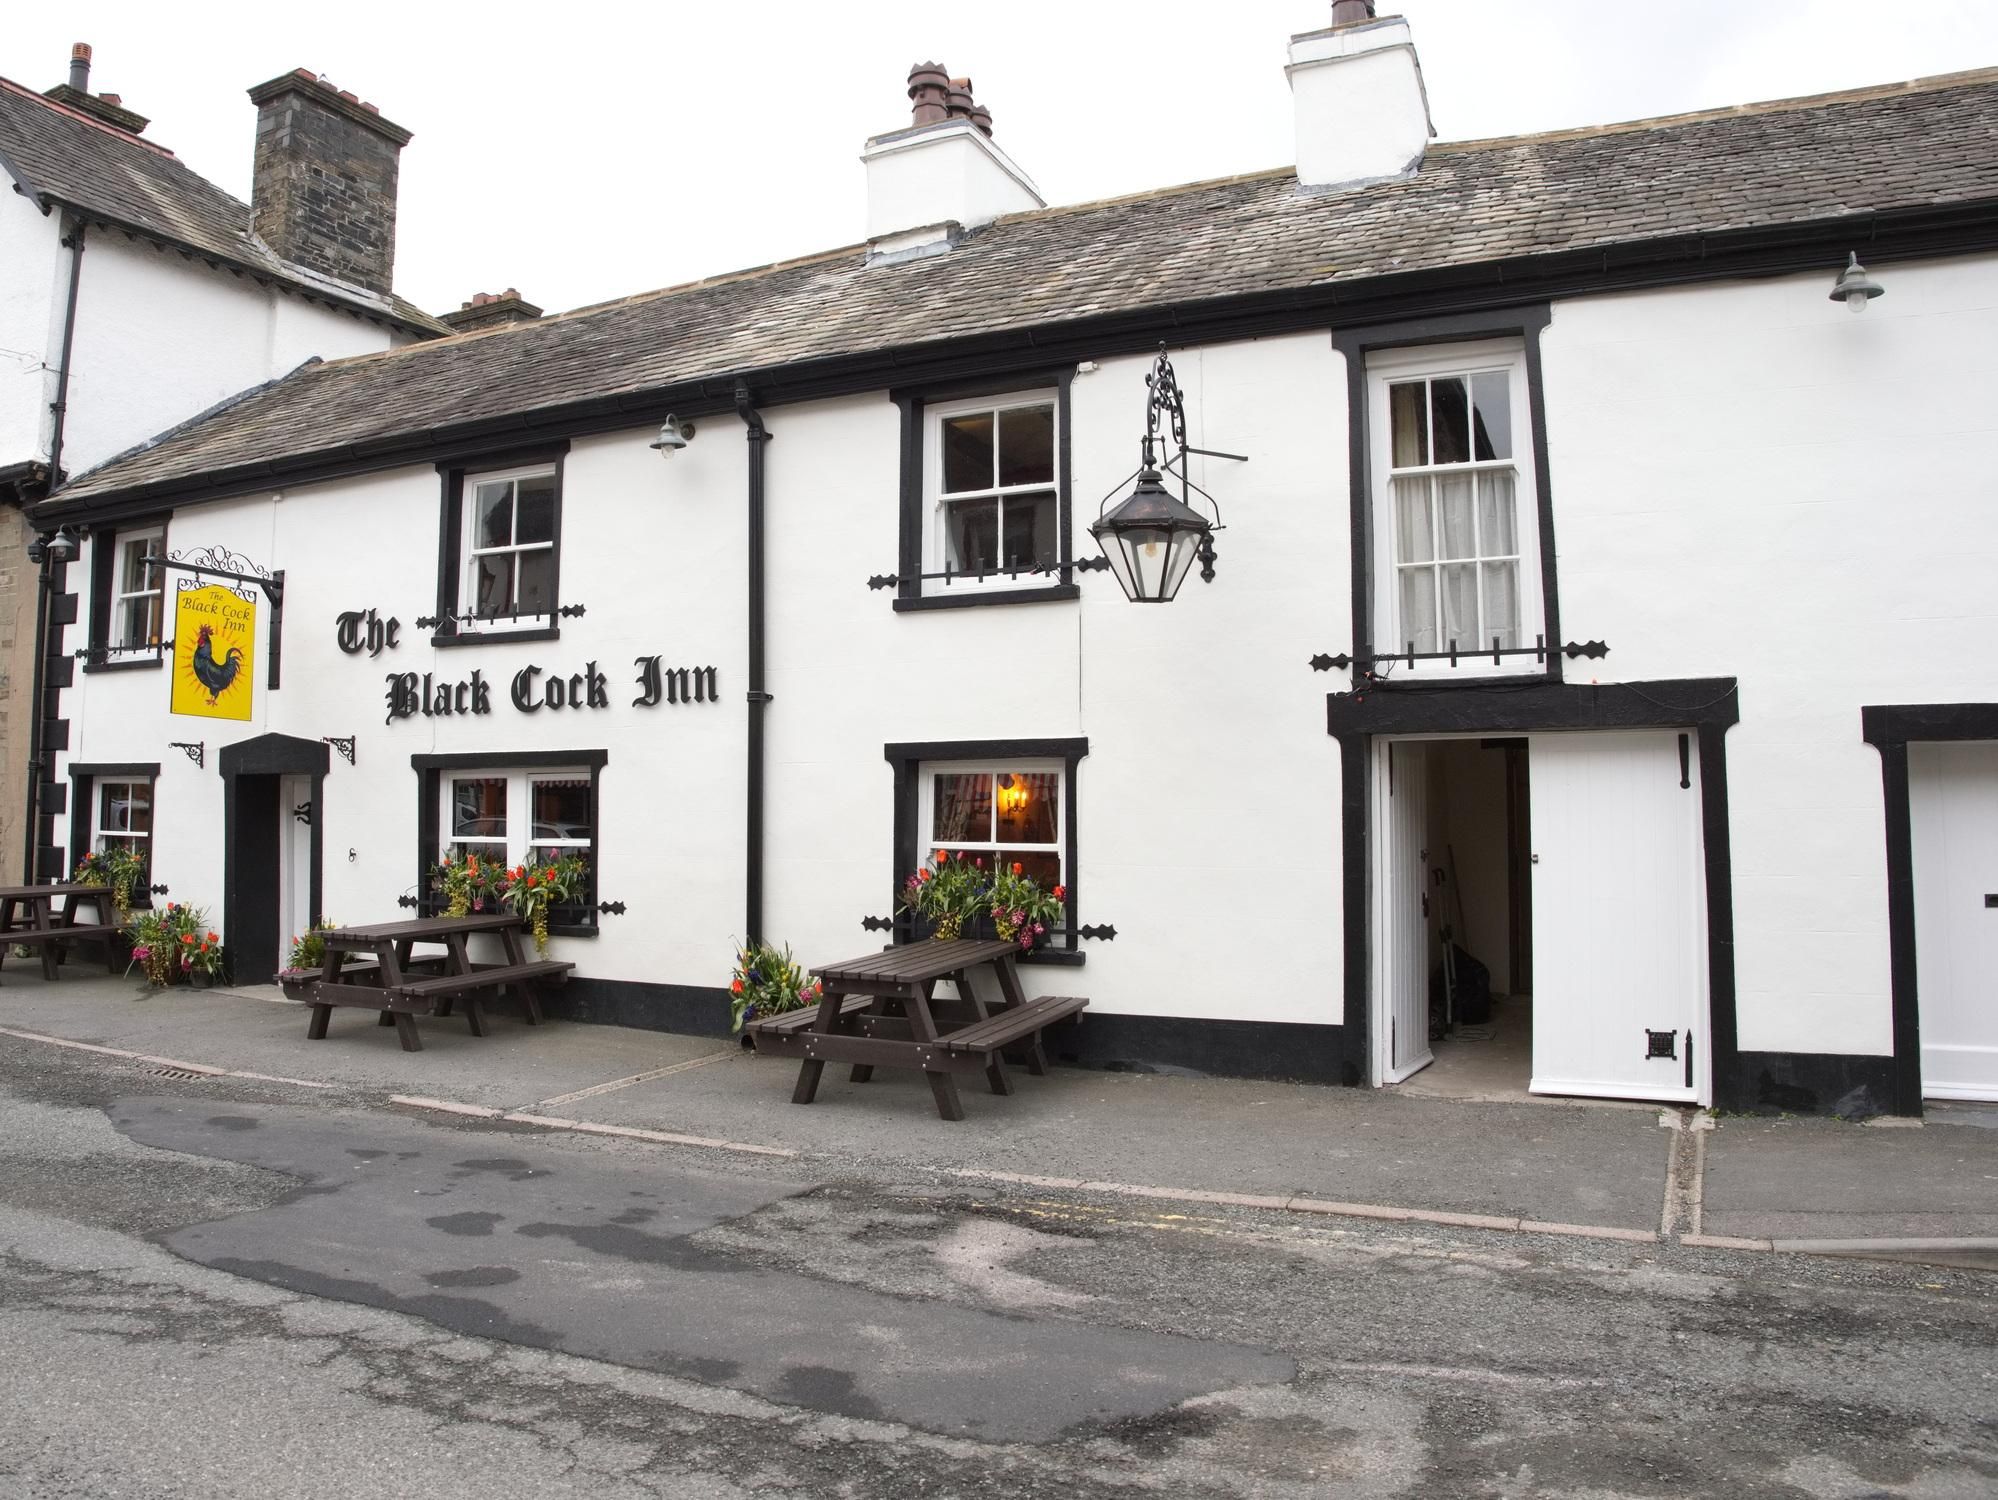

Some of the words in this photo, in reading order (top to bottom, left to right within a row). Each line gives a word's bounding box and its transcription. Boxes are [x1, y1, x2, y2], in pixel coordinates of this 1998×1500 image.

[209, 591, 224, 601] The
[182, 597, 218, 614] Black
[222, 605, 250, 621] Cock
[223, 618, 246, 632] Inn
[336, 607, 401, 659] The
[384, 668, 492, 726] Black
[511, 660, 609, 714] Cock
[631, 654, 720, 708] Inn
